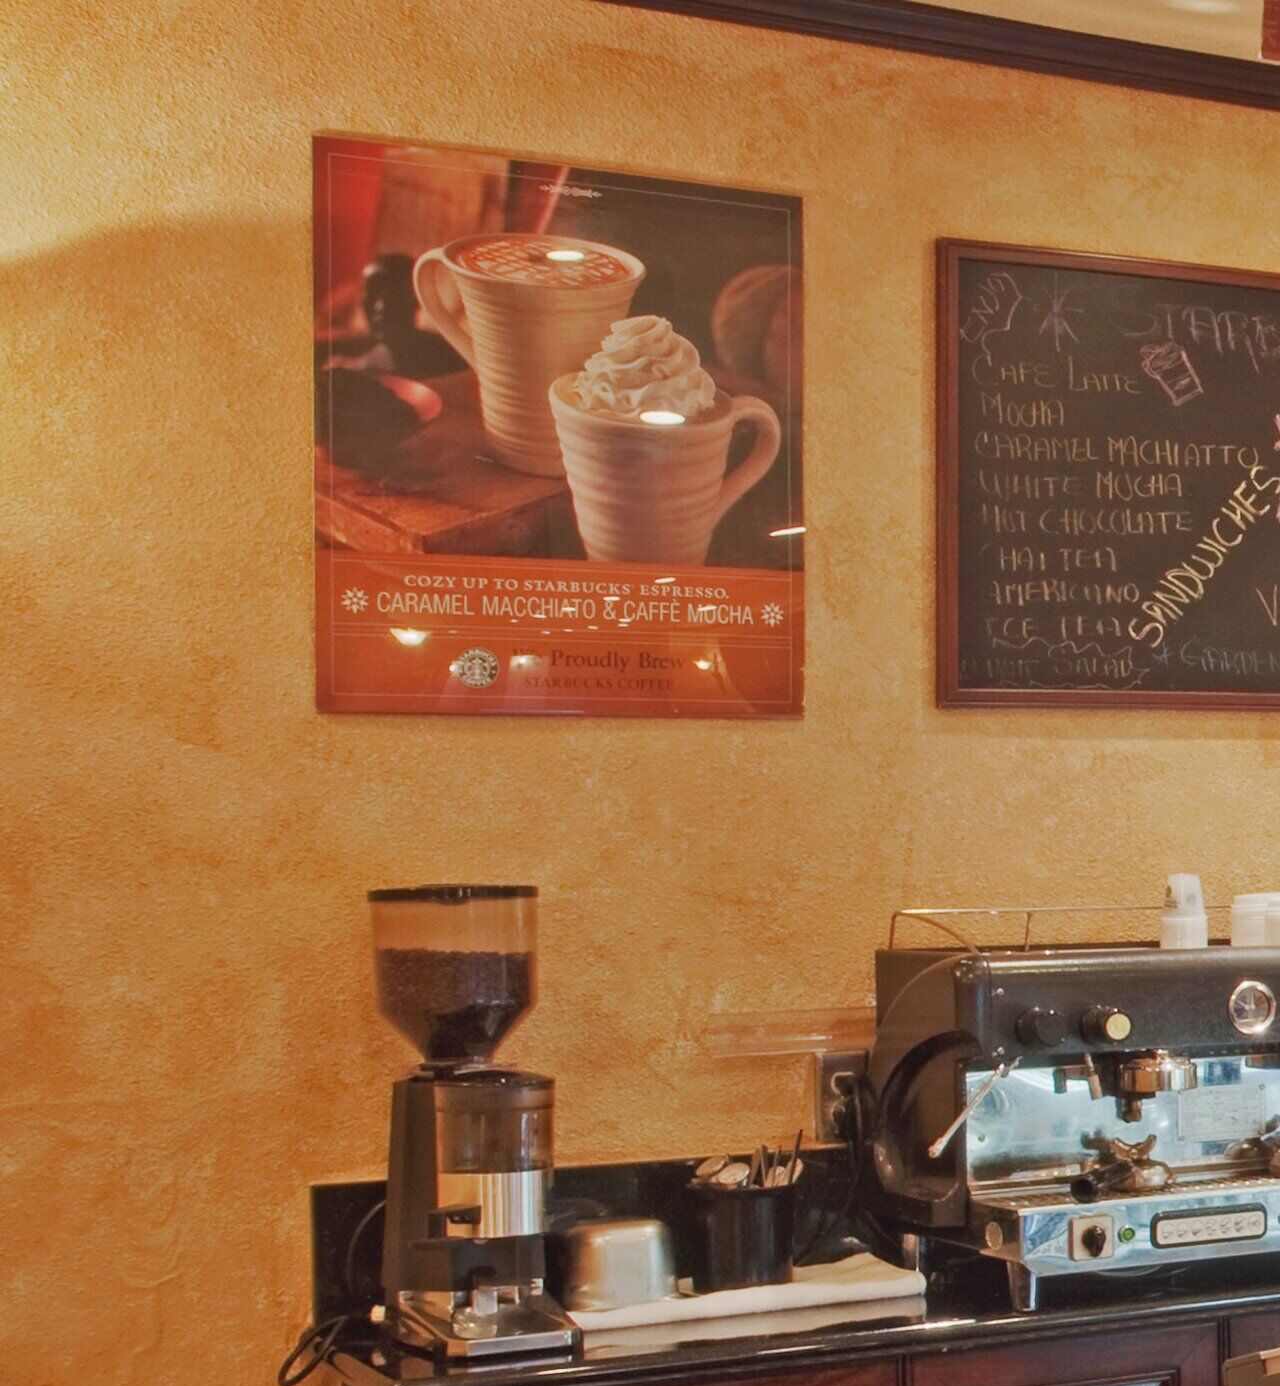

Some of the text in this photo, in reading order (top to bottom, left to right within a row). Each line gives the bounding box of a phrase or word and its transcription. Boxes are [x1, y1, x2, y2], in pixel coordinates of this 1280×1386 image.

[1068, 355, 1142, 394] LATTE
[974, 431, 1260, 468] CARAMEL MACHIATTO
[1040, 505, 1194, 535] CHOCOLATE
[404, 574, 729, 600] COZY UP TO STARBUCKS ESPRESSO.
[376, 590, 754, 626] CARAMEL MACCHIATO & CAFFÈ MOCHA
[550, 649, 629, 672] Proudly
[638, 651, 685, 669] Brew
[523, 675, 613, 691] STARBUCKS
